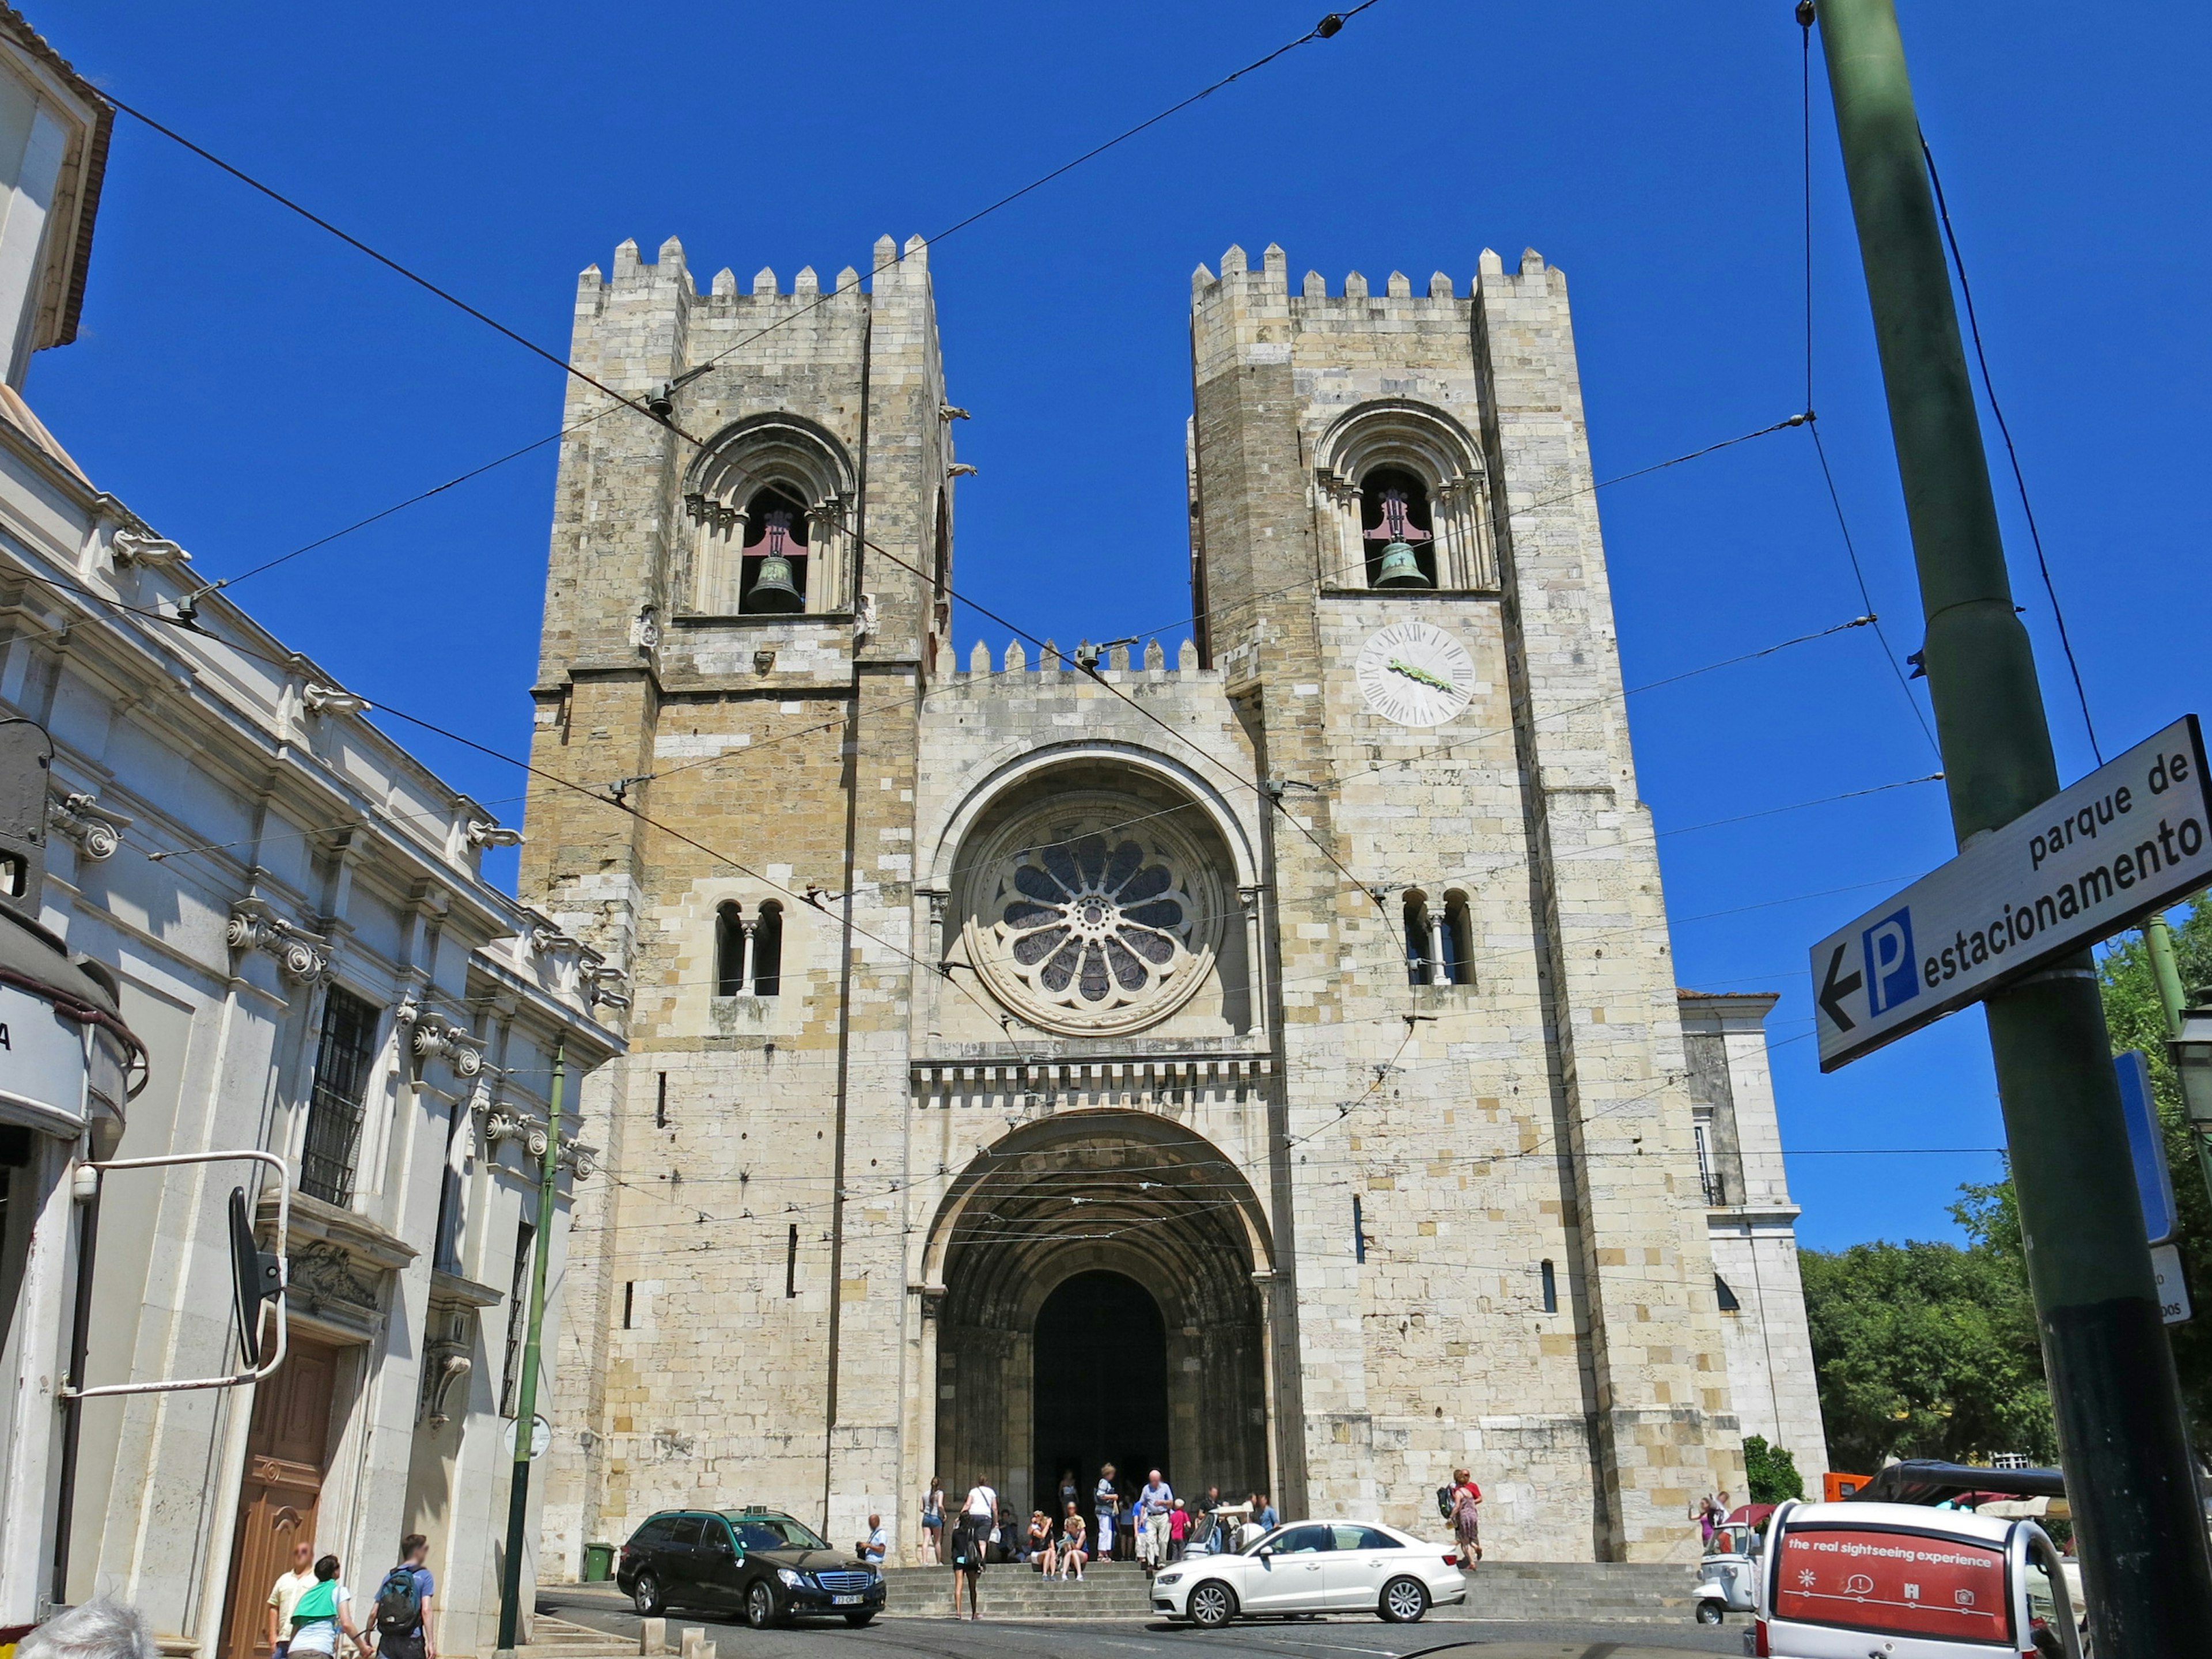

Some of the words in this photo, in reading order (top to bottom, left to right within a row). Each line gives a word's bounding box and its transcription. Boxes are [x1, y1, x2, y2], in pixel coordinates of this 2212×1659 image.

[1381, 628, 1400, 648] XI
[1403, 624, 1422, 642] XII
[1431, 631, 1440, 645] I
[1364, 646, 1384, 660] X
[1445, 647, 1464, 660] II
[1359, 668, 1380, 680] IX
[1452, 669, 1472, 679] III
[1438, 704, 1451, 720] V
[2029, 786, 2133, 872] parque
[2148, 753, 2189, 795] de
[1924, 818, 2202, 988] estacionamento
[1870, 921, 1906, 1012] P
[1789, 1538, 1809, 1550] the
[1813, 1541, 1839, 1552] real
[1840, 1544, 1915, 1562] sightseeing
[1916, 1551, 1992, 1568] experience
